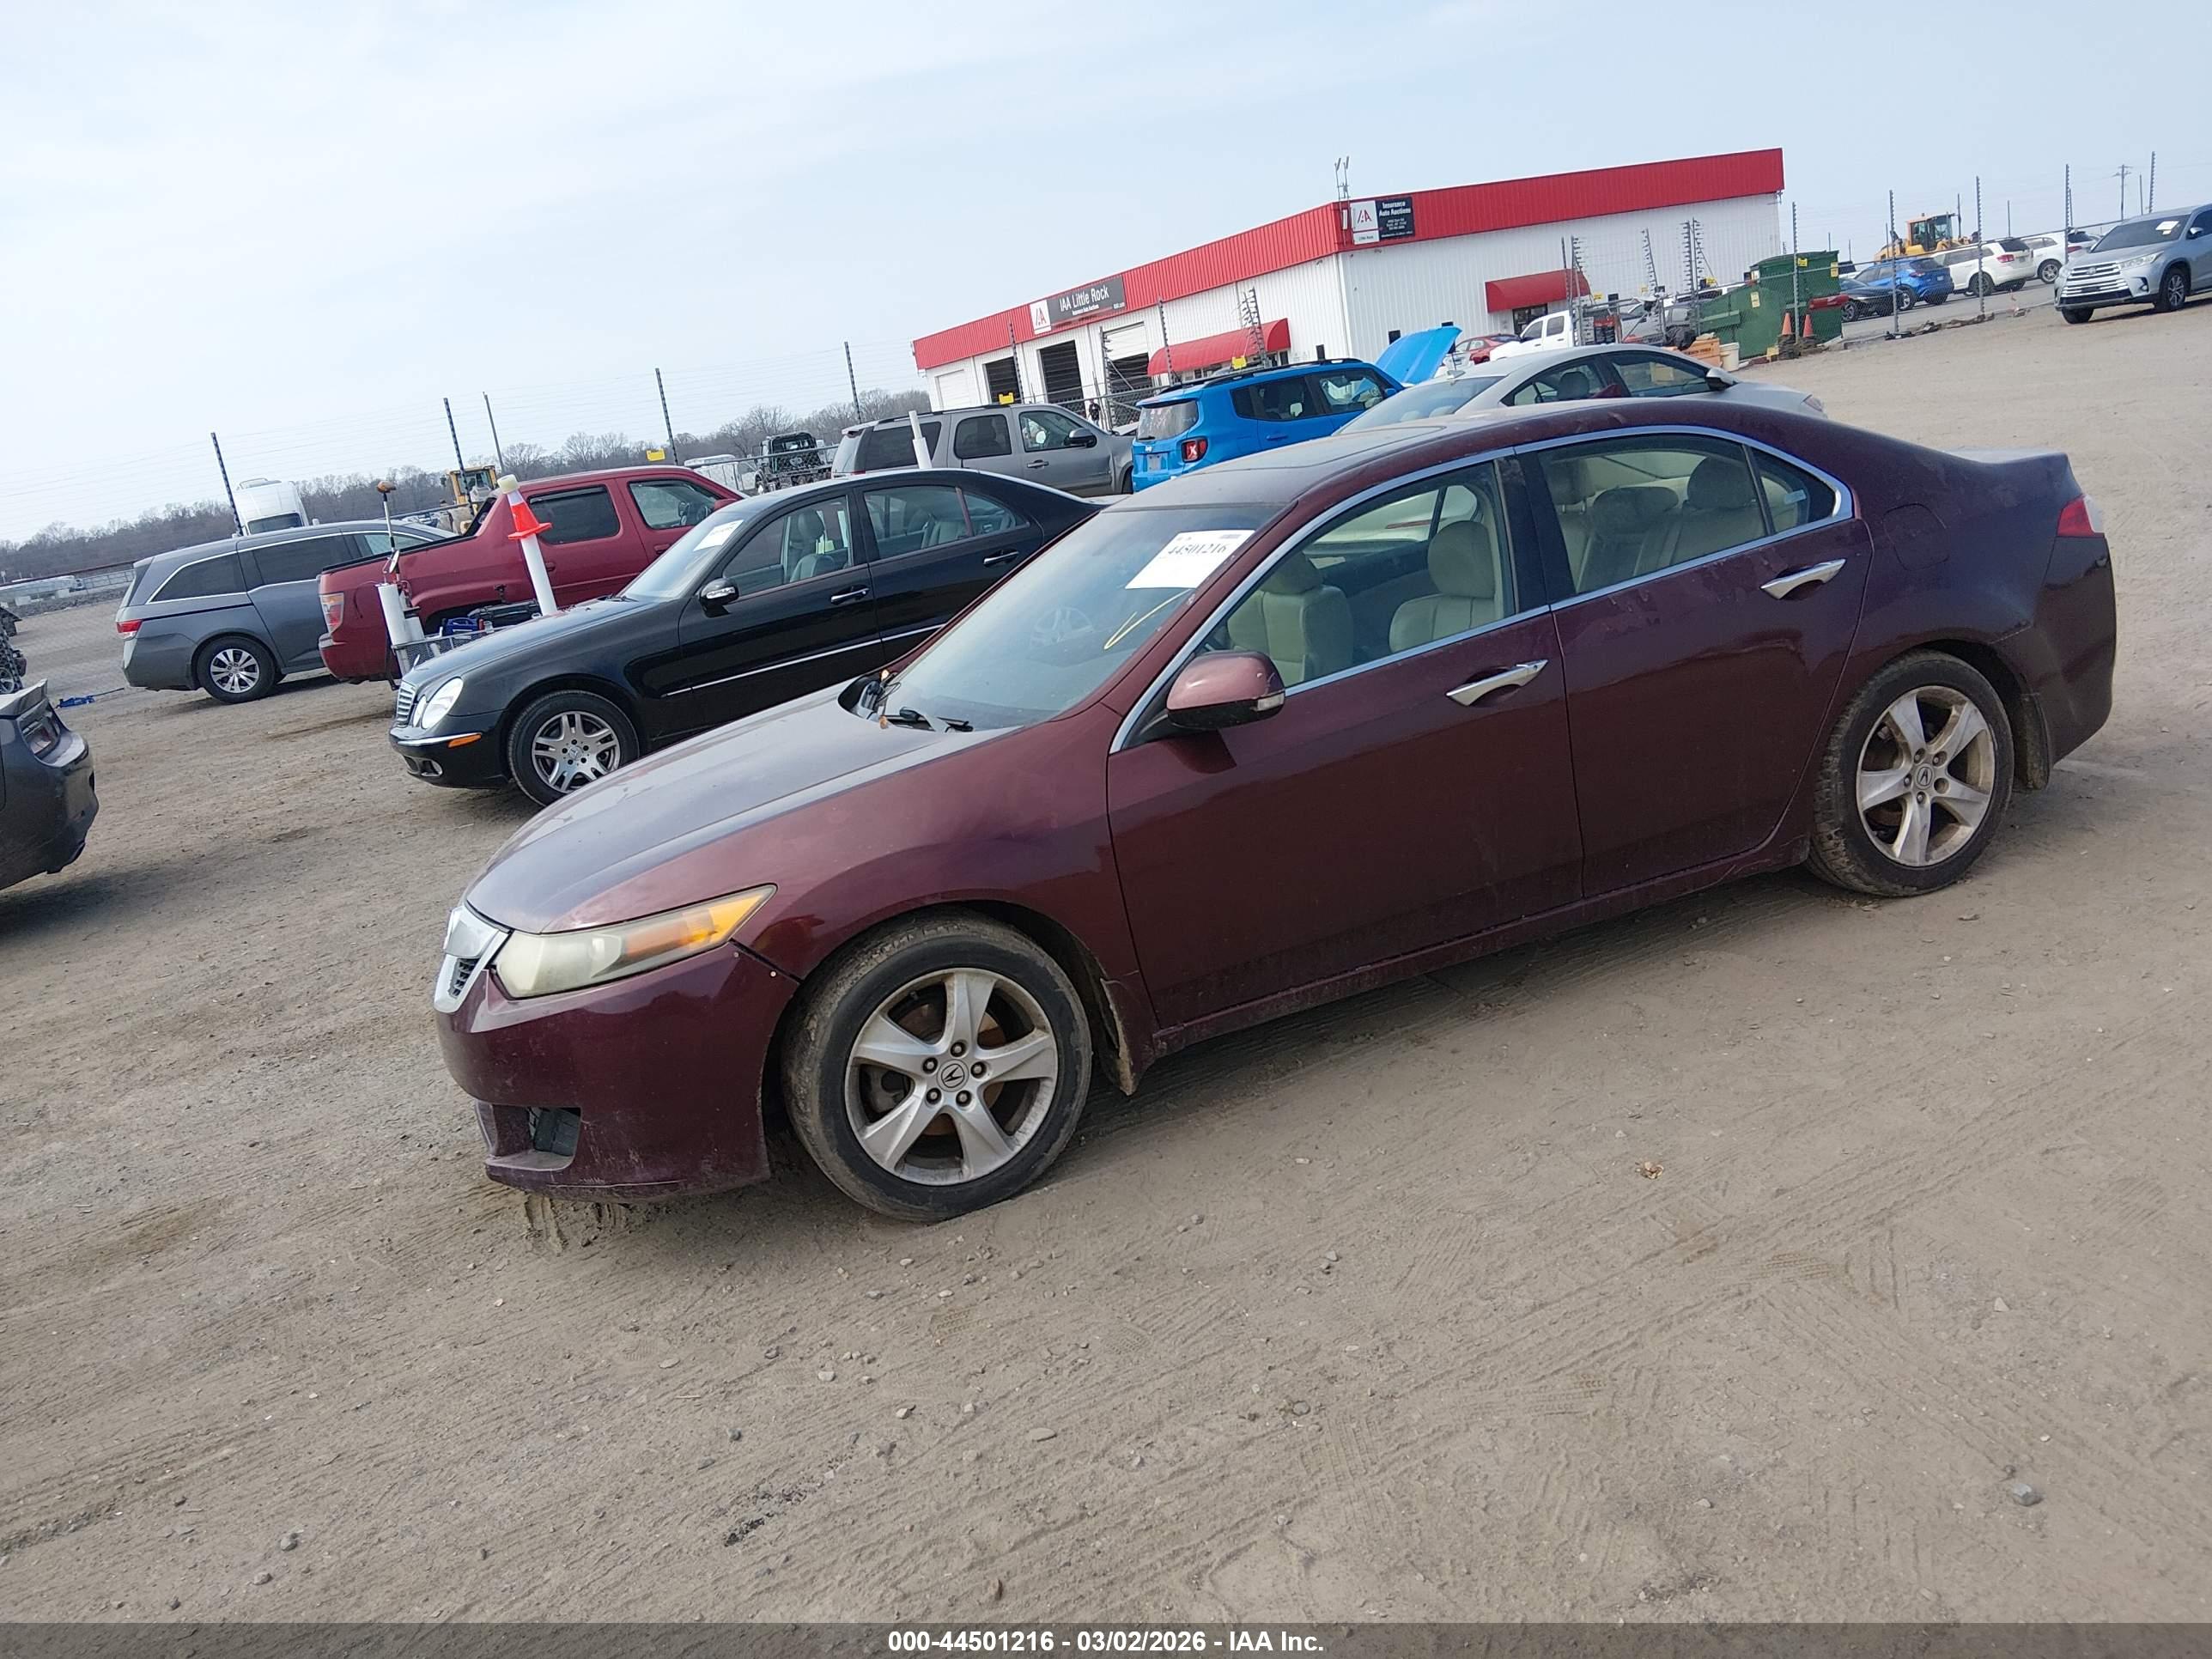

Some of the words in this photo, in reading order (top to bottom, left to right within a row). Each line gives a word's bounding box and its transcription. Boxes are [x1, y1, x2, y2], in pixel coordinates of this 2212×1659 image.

[1059, 298, 1072, 312] IAA
[1072, 291, 1090, 308] Little
[1091, 284, 1109, 303] Rock
